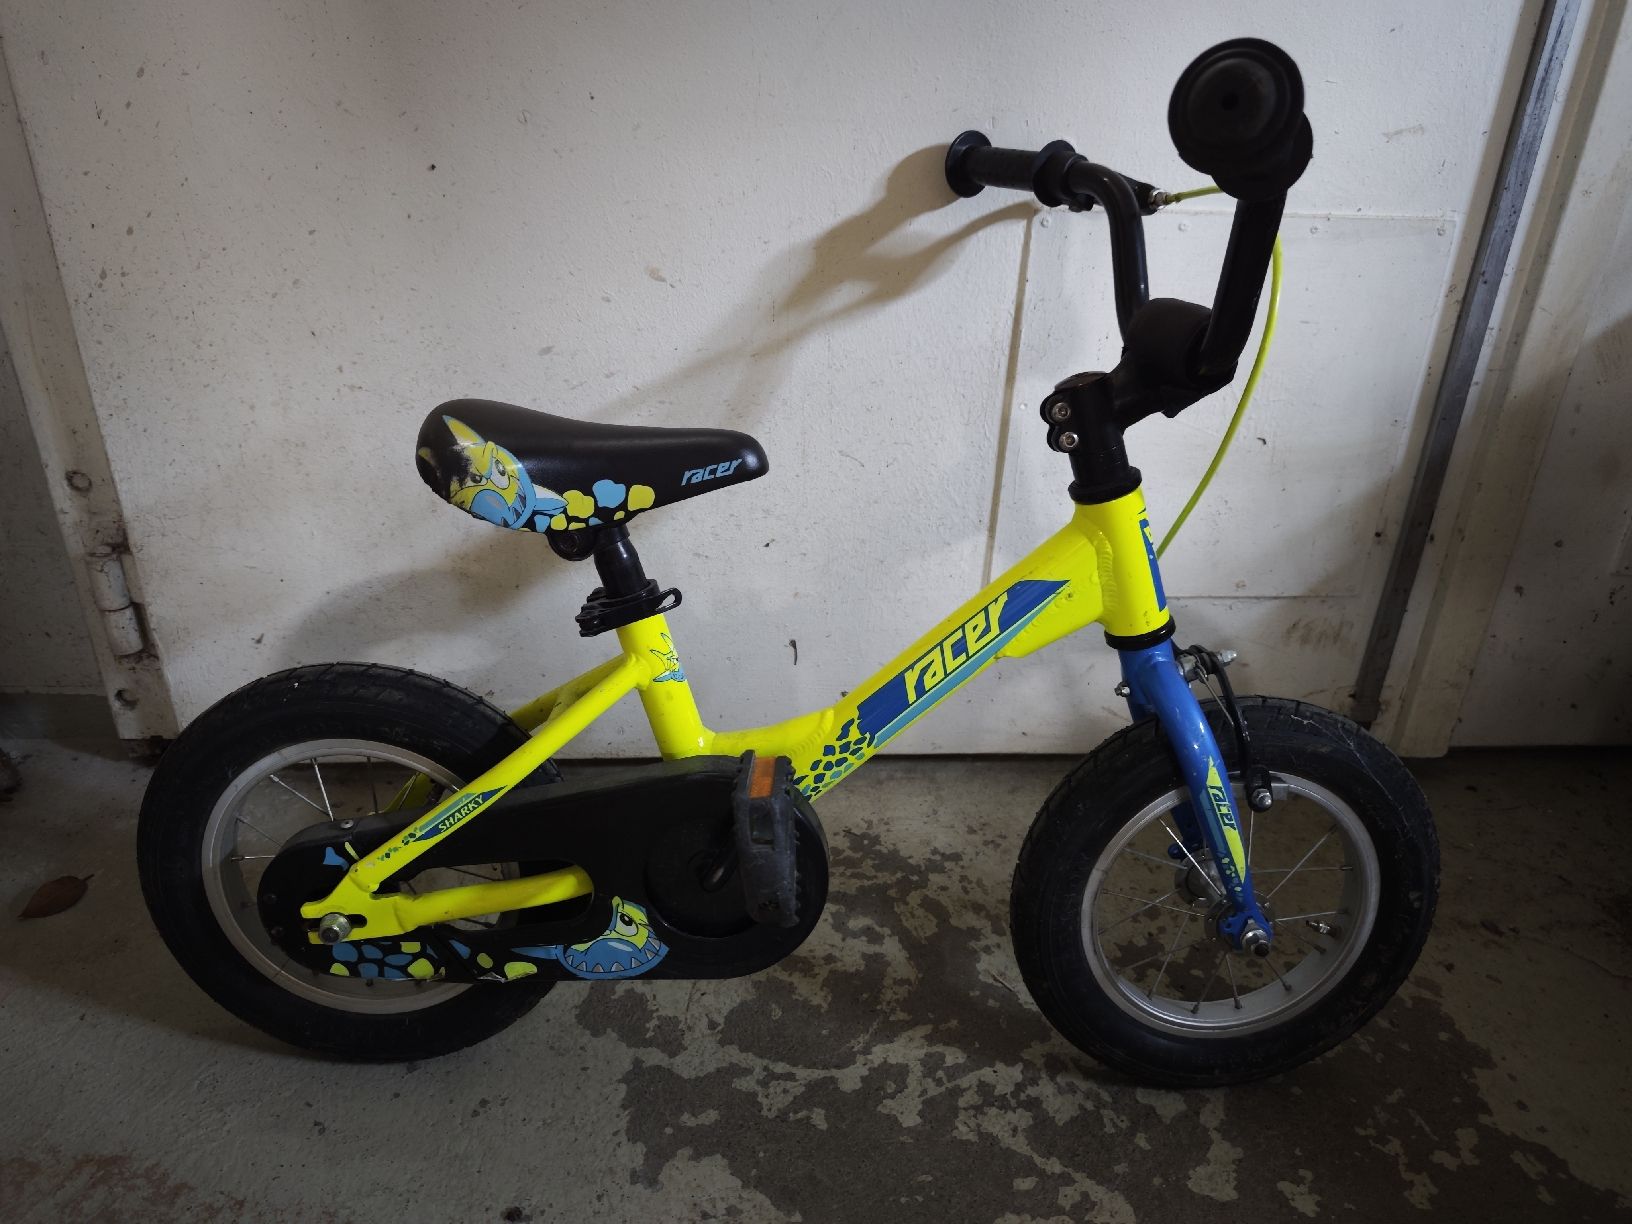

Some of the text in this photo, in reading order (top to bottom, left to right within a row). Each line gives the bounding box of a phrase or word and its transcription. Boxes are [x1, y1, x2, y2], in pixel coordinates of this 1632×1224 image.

[681, 458, 743, 487] racer
[903, 590, 1009, 705] racer
[437, 794, 485, 833] SHARKY
[1207, 784, 1238, 831] racer
